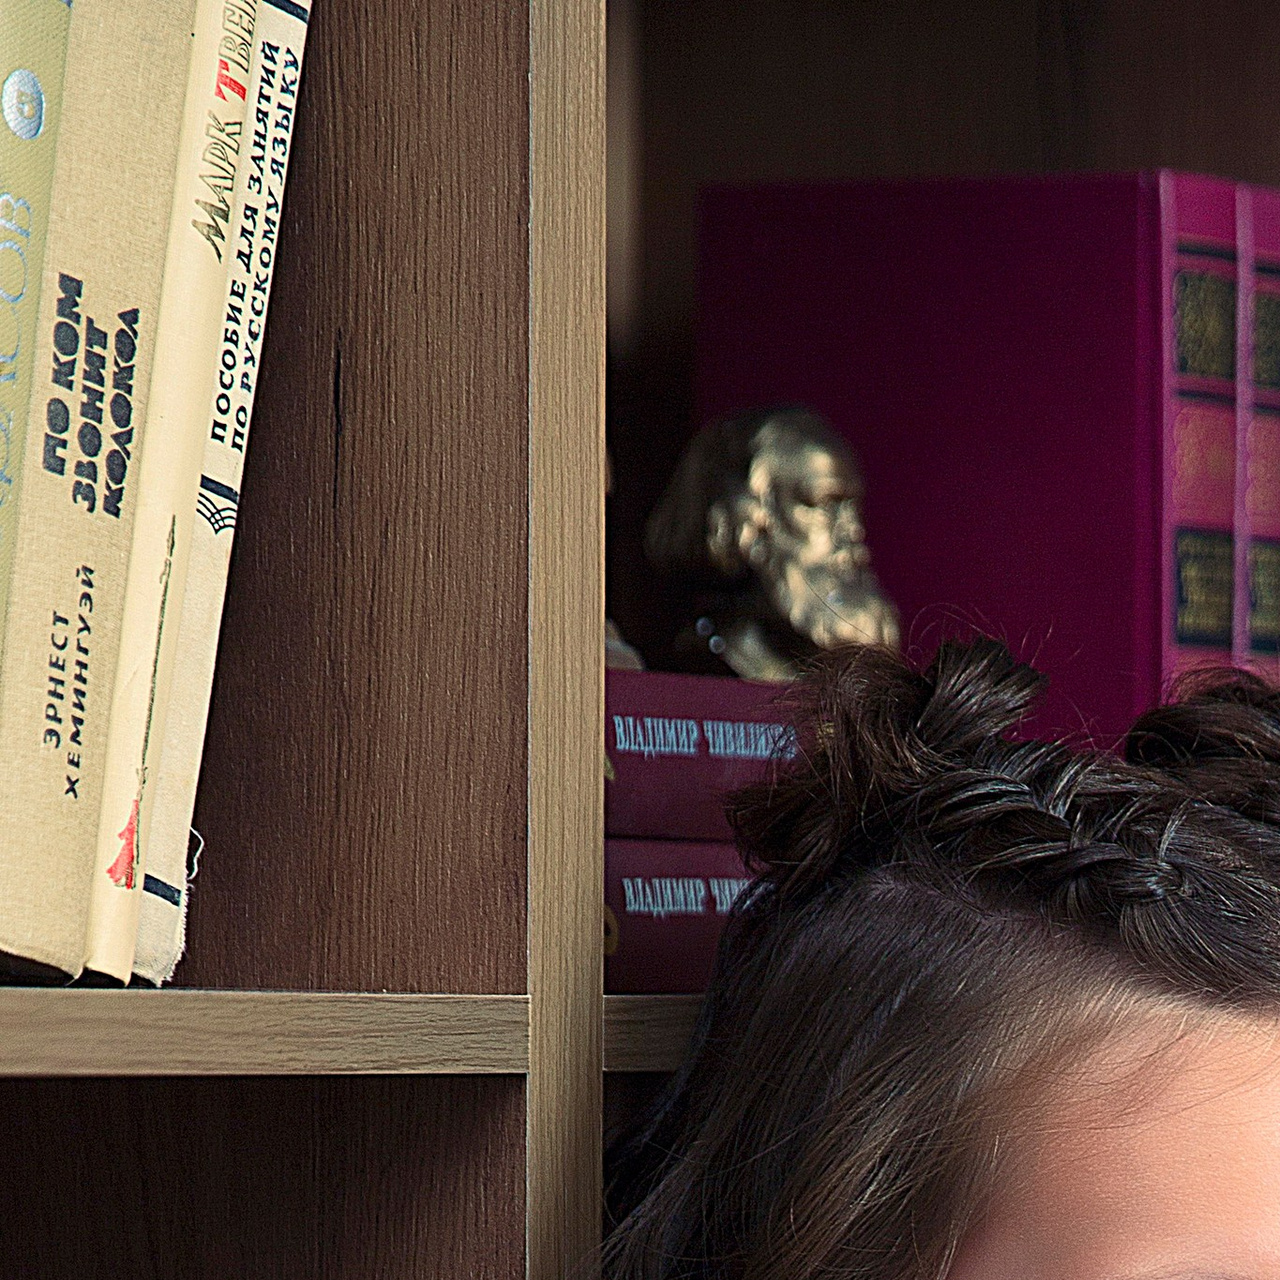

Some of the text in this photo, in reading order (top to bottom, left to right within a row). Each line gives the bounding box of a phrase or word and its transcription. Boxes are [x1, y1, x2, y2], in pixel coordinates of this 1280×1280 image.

[191, 109, 243, 264] МАРК
[210, 40, 280, 445] ПОСОБИЕ ДЛЯ ЗАНЯТИЙ
[231, 46, 300, 454] ПО РУССКОМУ ЯЗЫКУ
[42, 272, 83, 476] ПО КОМ
[72, 315, 108, 514] ЗВОНИТ
[102, 307, 140, 519] КОЛОКОЛ
[42, 610, 70, 749] ЭРНЕСТ
[64, 564, 96, 800] ХЕМИНГУЭЙ
[613, 715, 698, 761] ВЛАДИМИР
[622, 878, 705, 920] ВЛАДИМИР
